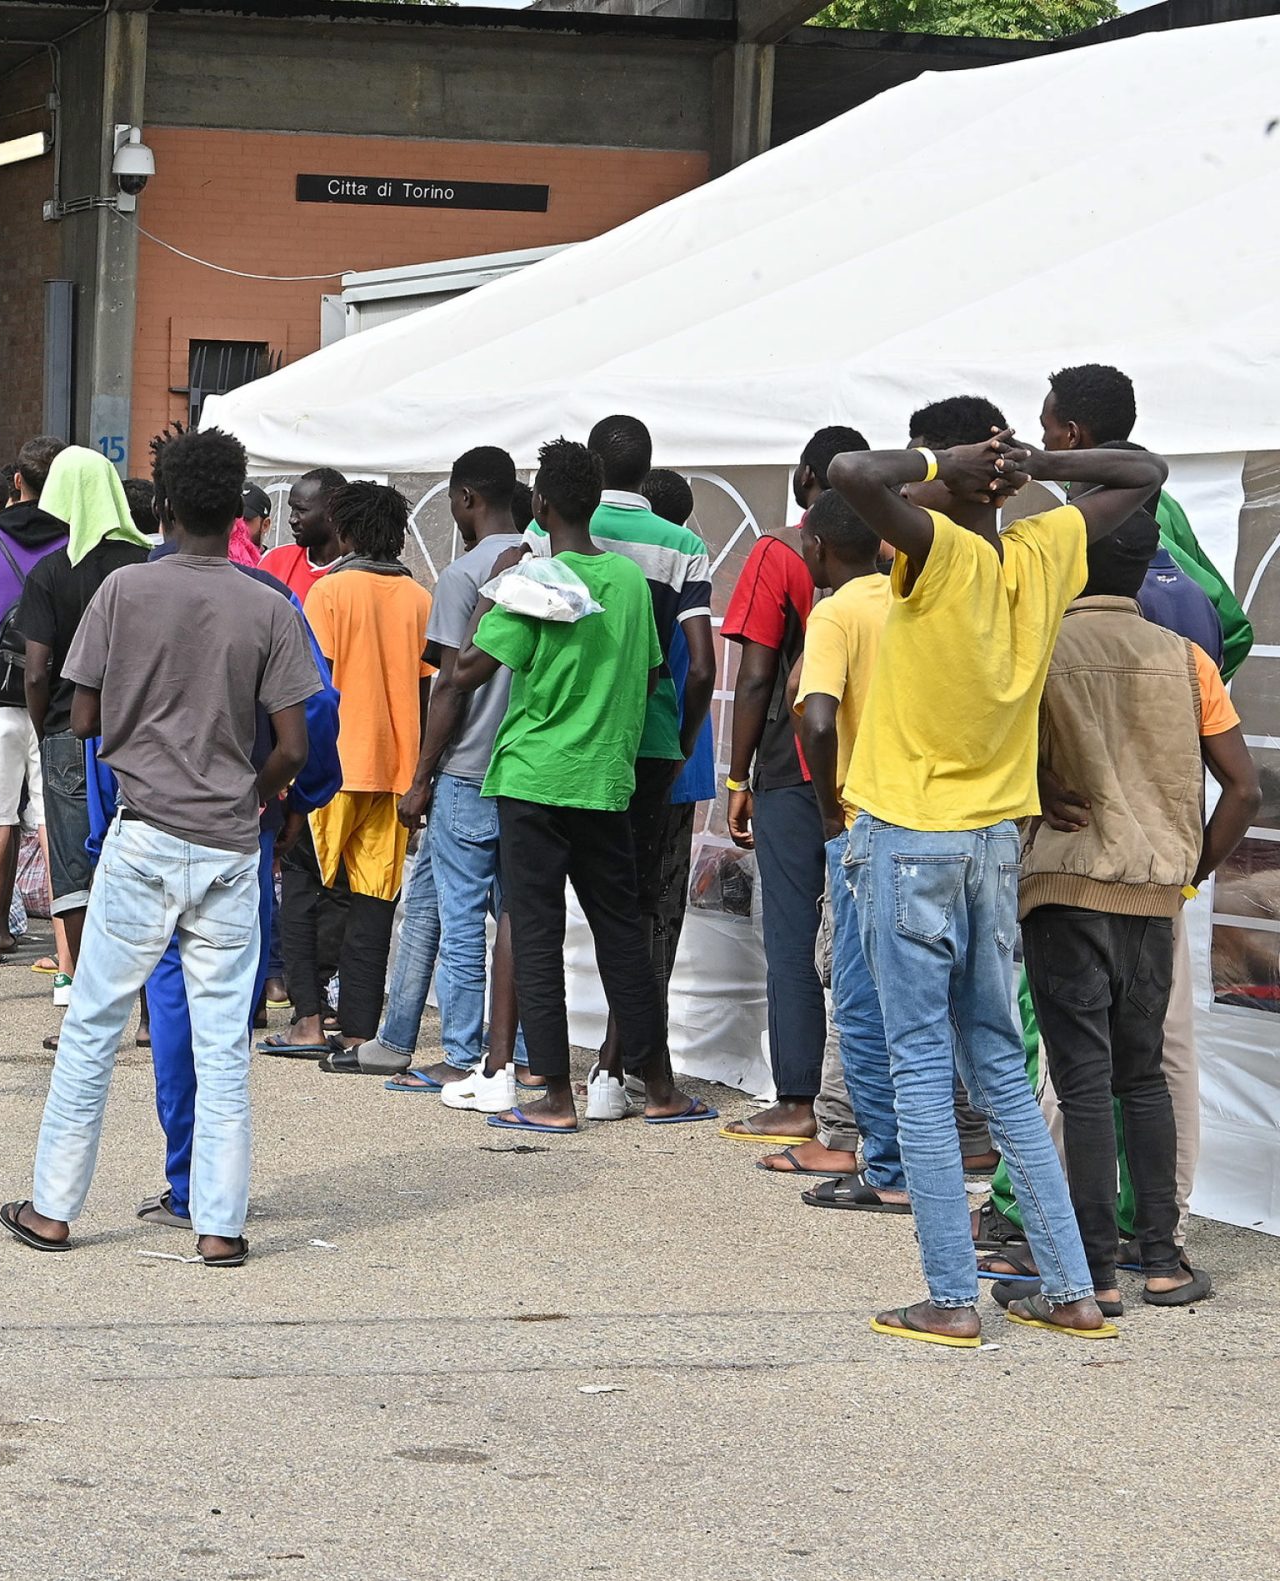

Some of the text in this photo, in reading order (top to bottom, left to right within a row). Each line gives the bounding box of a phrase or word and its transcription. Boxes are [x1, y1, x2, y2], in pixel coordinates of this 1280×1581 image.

[377, 182, 392, 197] di
[402, 182, 455, 200] Torino
[98, 435, 125, 463] 15
